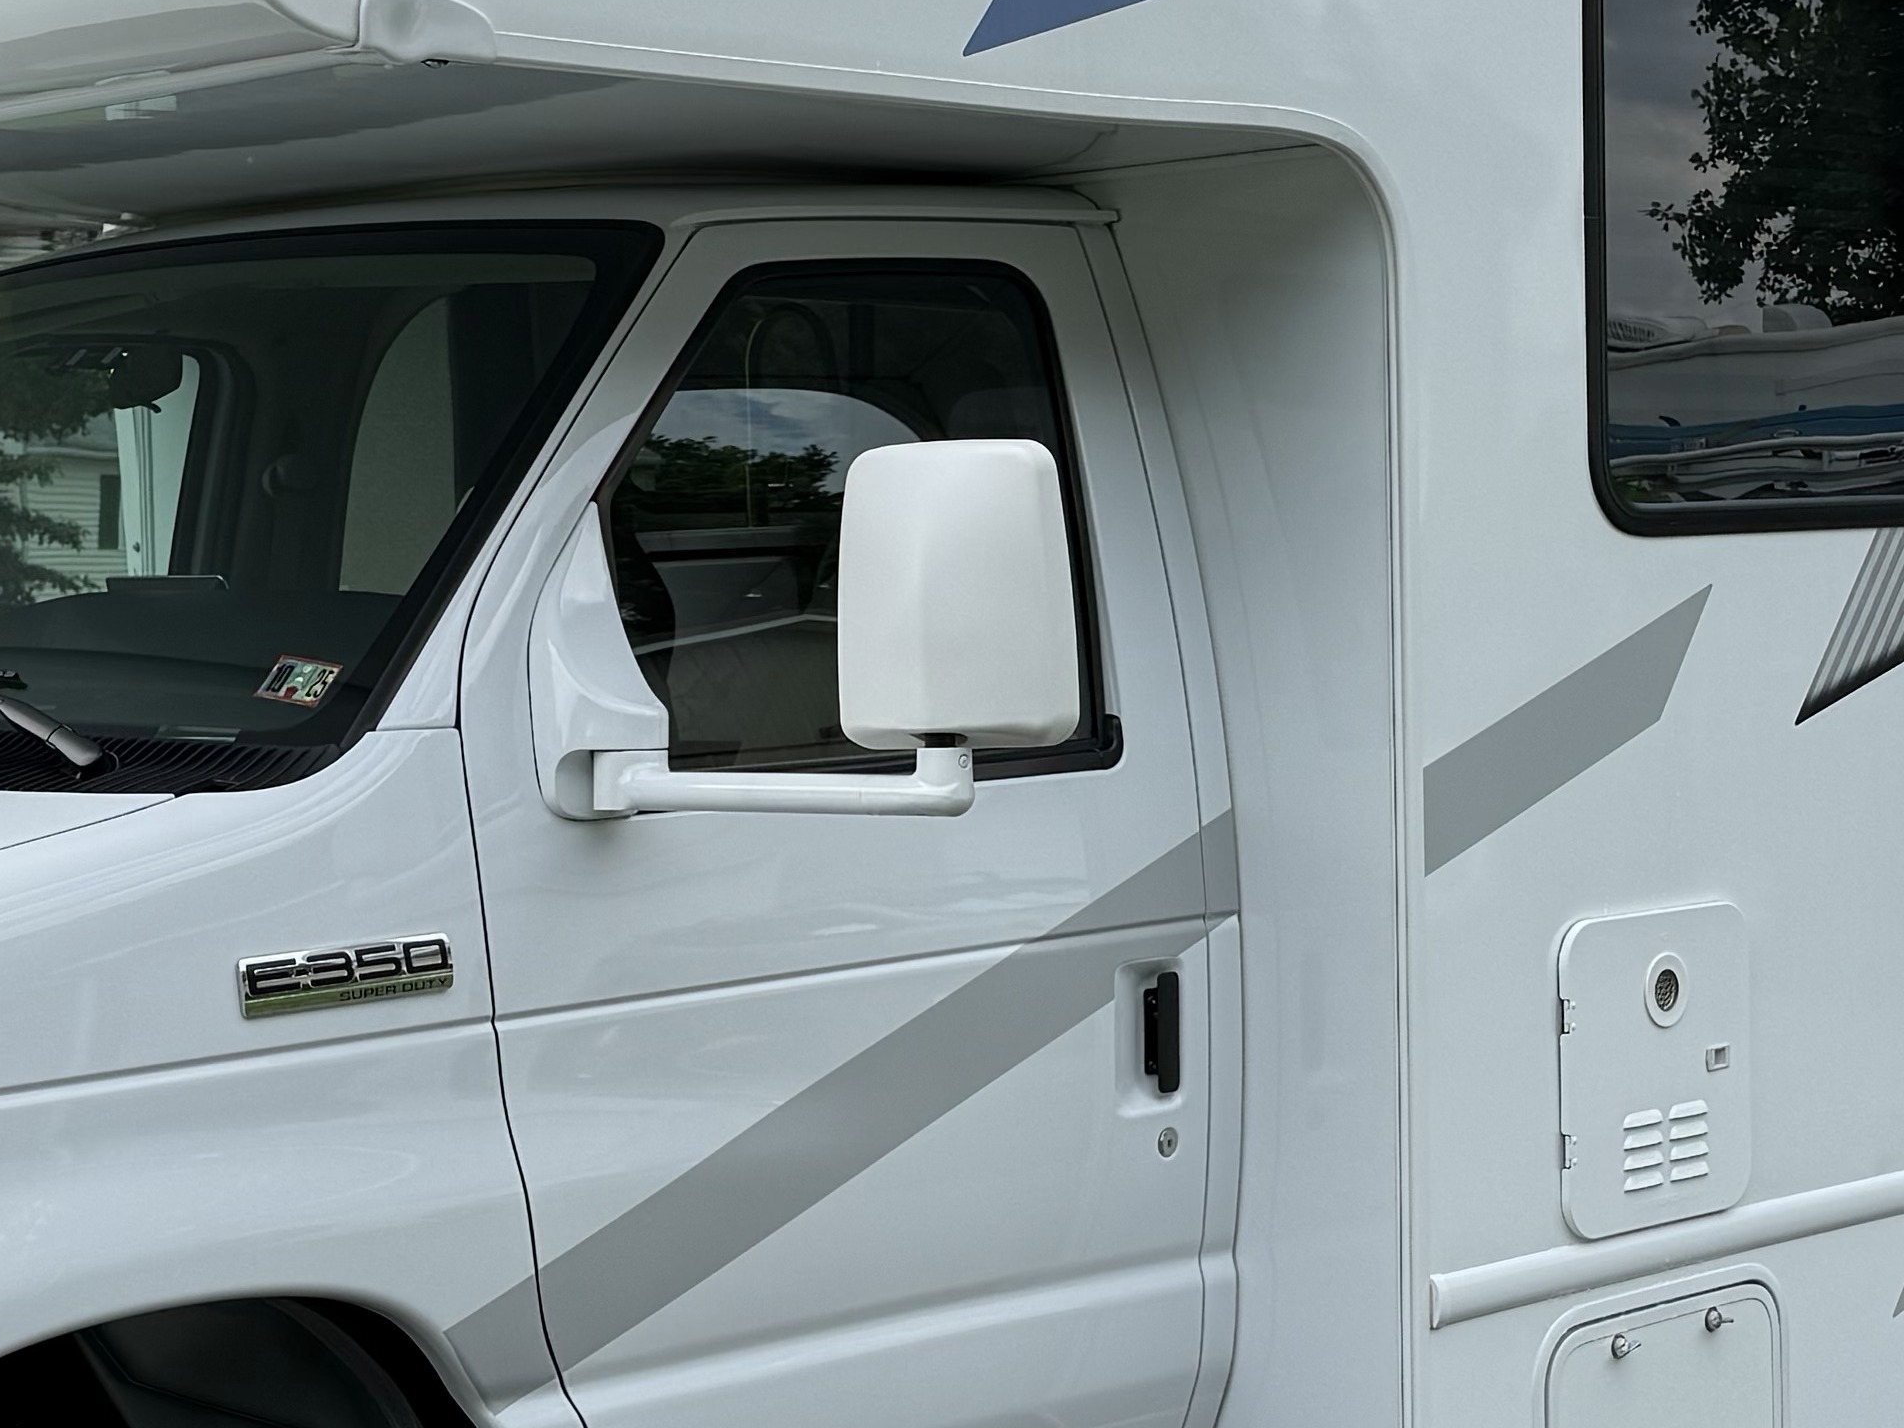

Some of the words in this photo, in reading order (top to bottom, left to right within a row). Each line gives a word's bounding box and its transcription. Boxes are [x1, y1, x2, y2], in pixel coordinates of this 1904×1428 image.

[266, 663, 295, 692] 10
[305, 669, 334, 698] 25
[247, 938, 448, 996] E-350
[338, 985, 398, 1002] SUPER
[401, 977, 448, 994] DUTY
